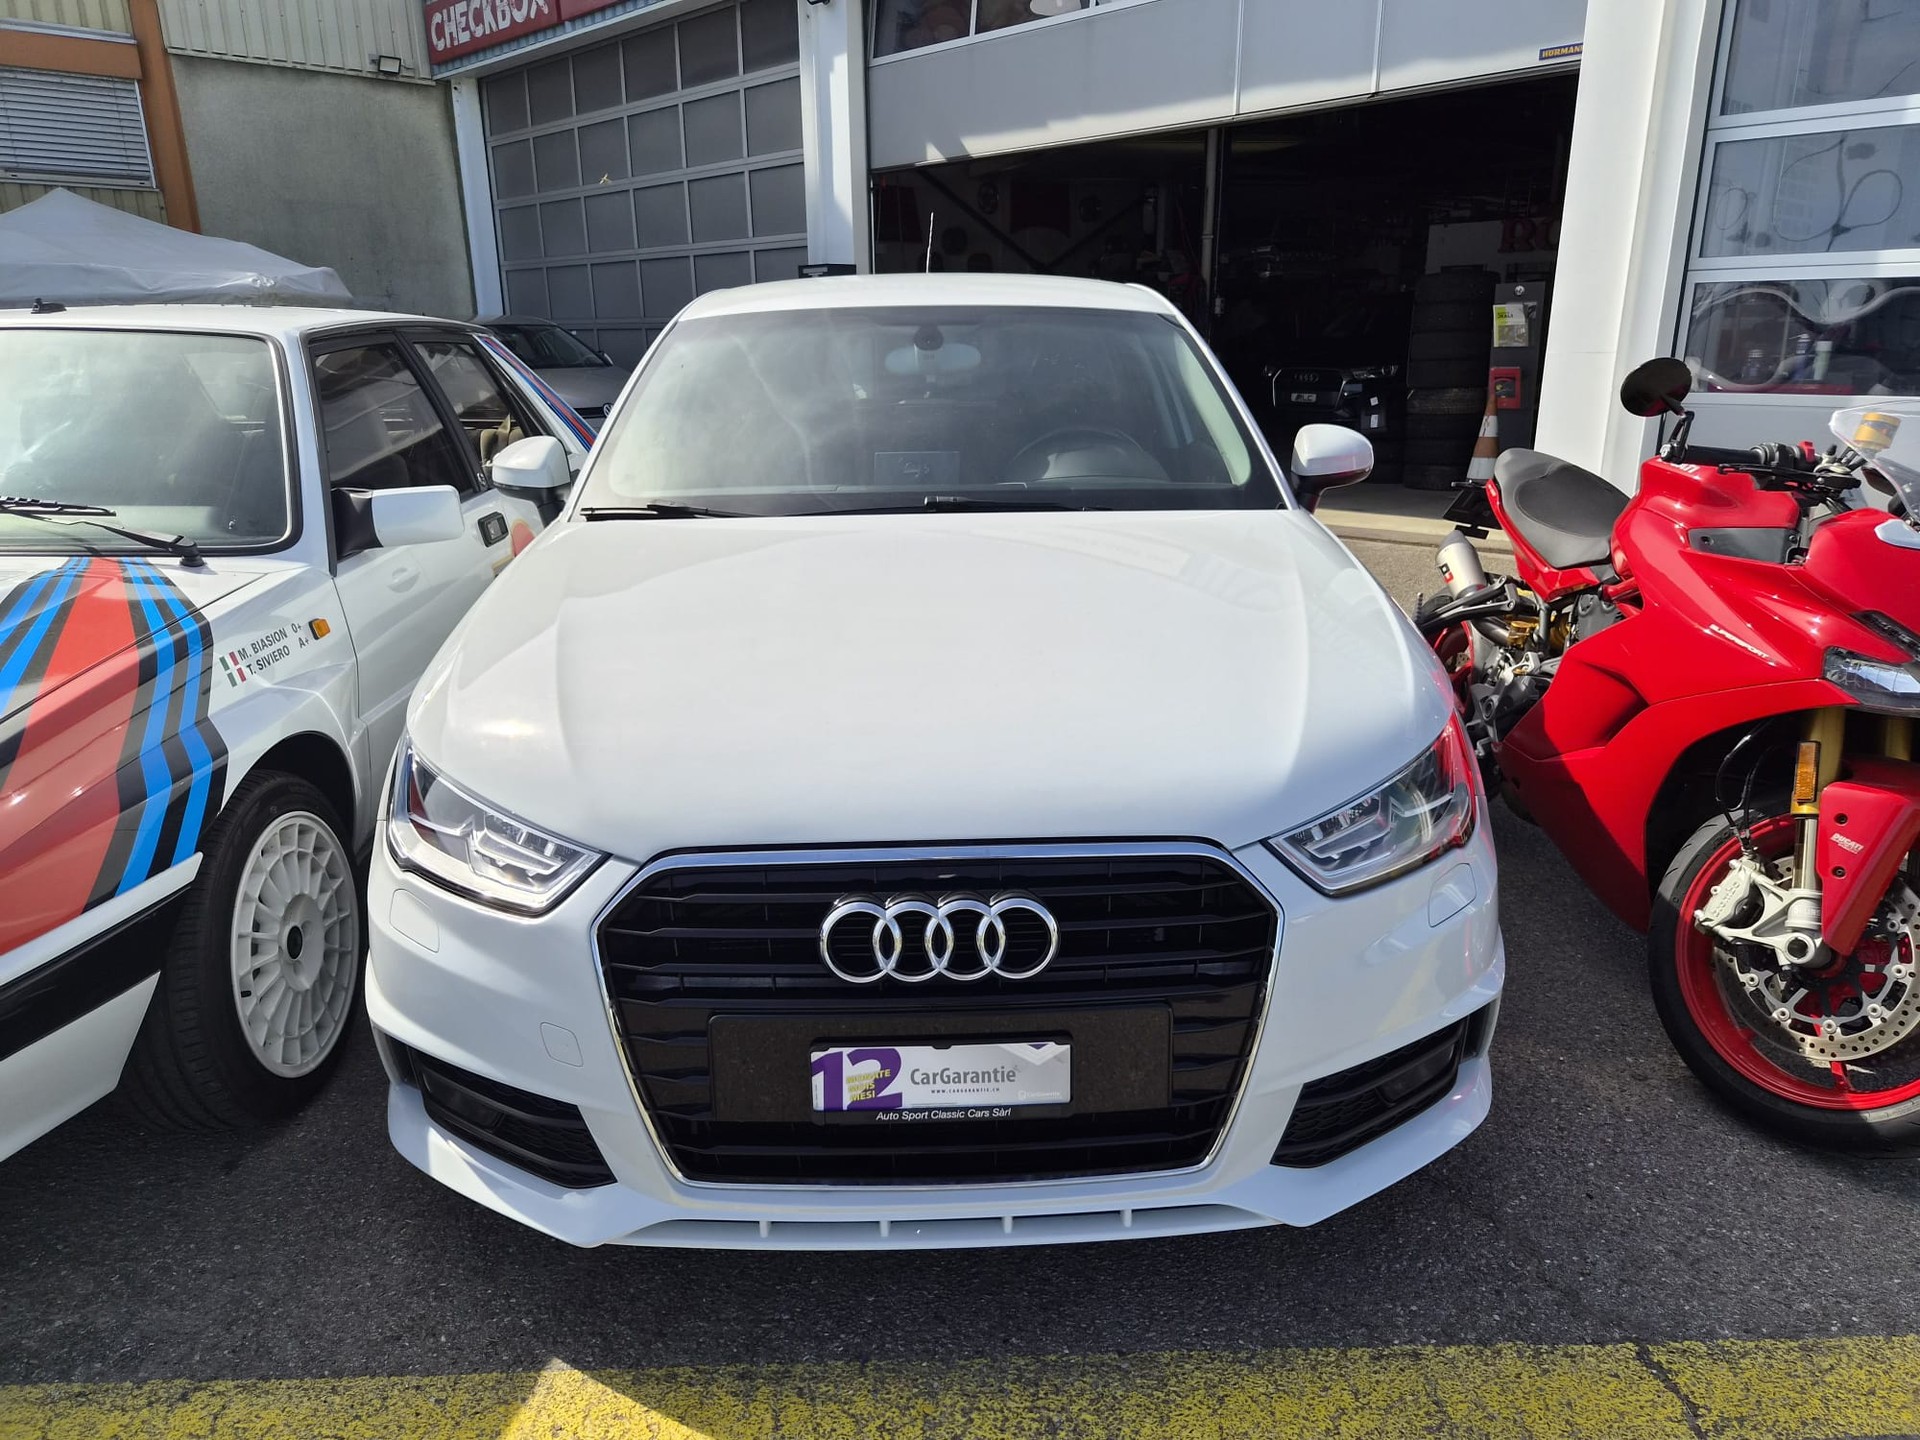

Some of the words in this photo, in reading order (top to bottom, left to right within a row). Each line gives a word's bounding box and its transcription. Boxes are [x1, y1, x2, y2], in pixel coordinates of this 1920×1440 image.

[431, 0, 549, 51] CHECKBOX
[237, 648, 252, 661] M.
[250, 628, 288, 655] BIASION
[246, 664, 257, 676] T.
[256, 645, 291, 671] SIVIERO
[298, 637, 310, 649] A+
[811, 1047, 903, 1110] 12
[910, 1066, 1016, 1085] CarGarantie
[850, 1090, 876, 1101] MESI
[876, 1112, 900, 1121] Auto
[902, 1110, 929, 1122] Sport
[931, 1110, 965, 1119] Classic
[967, 1109, 990, 1118] Cars
